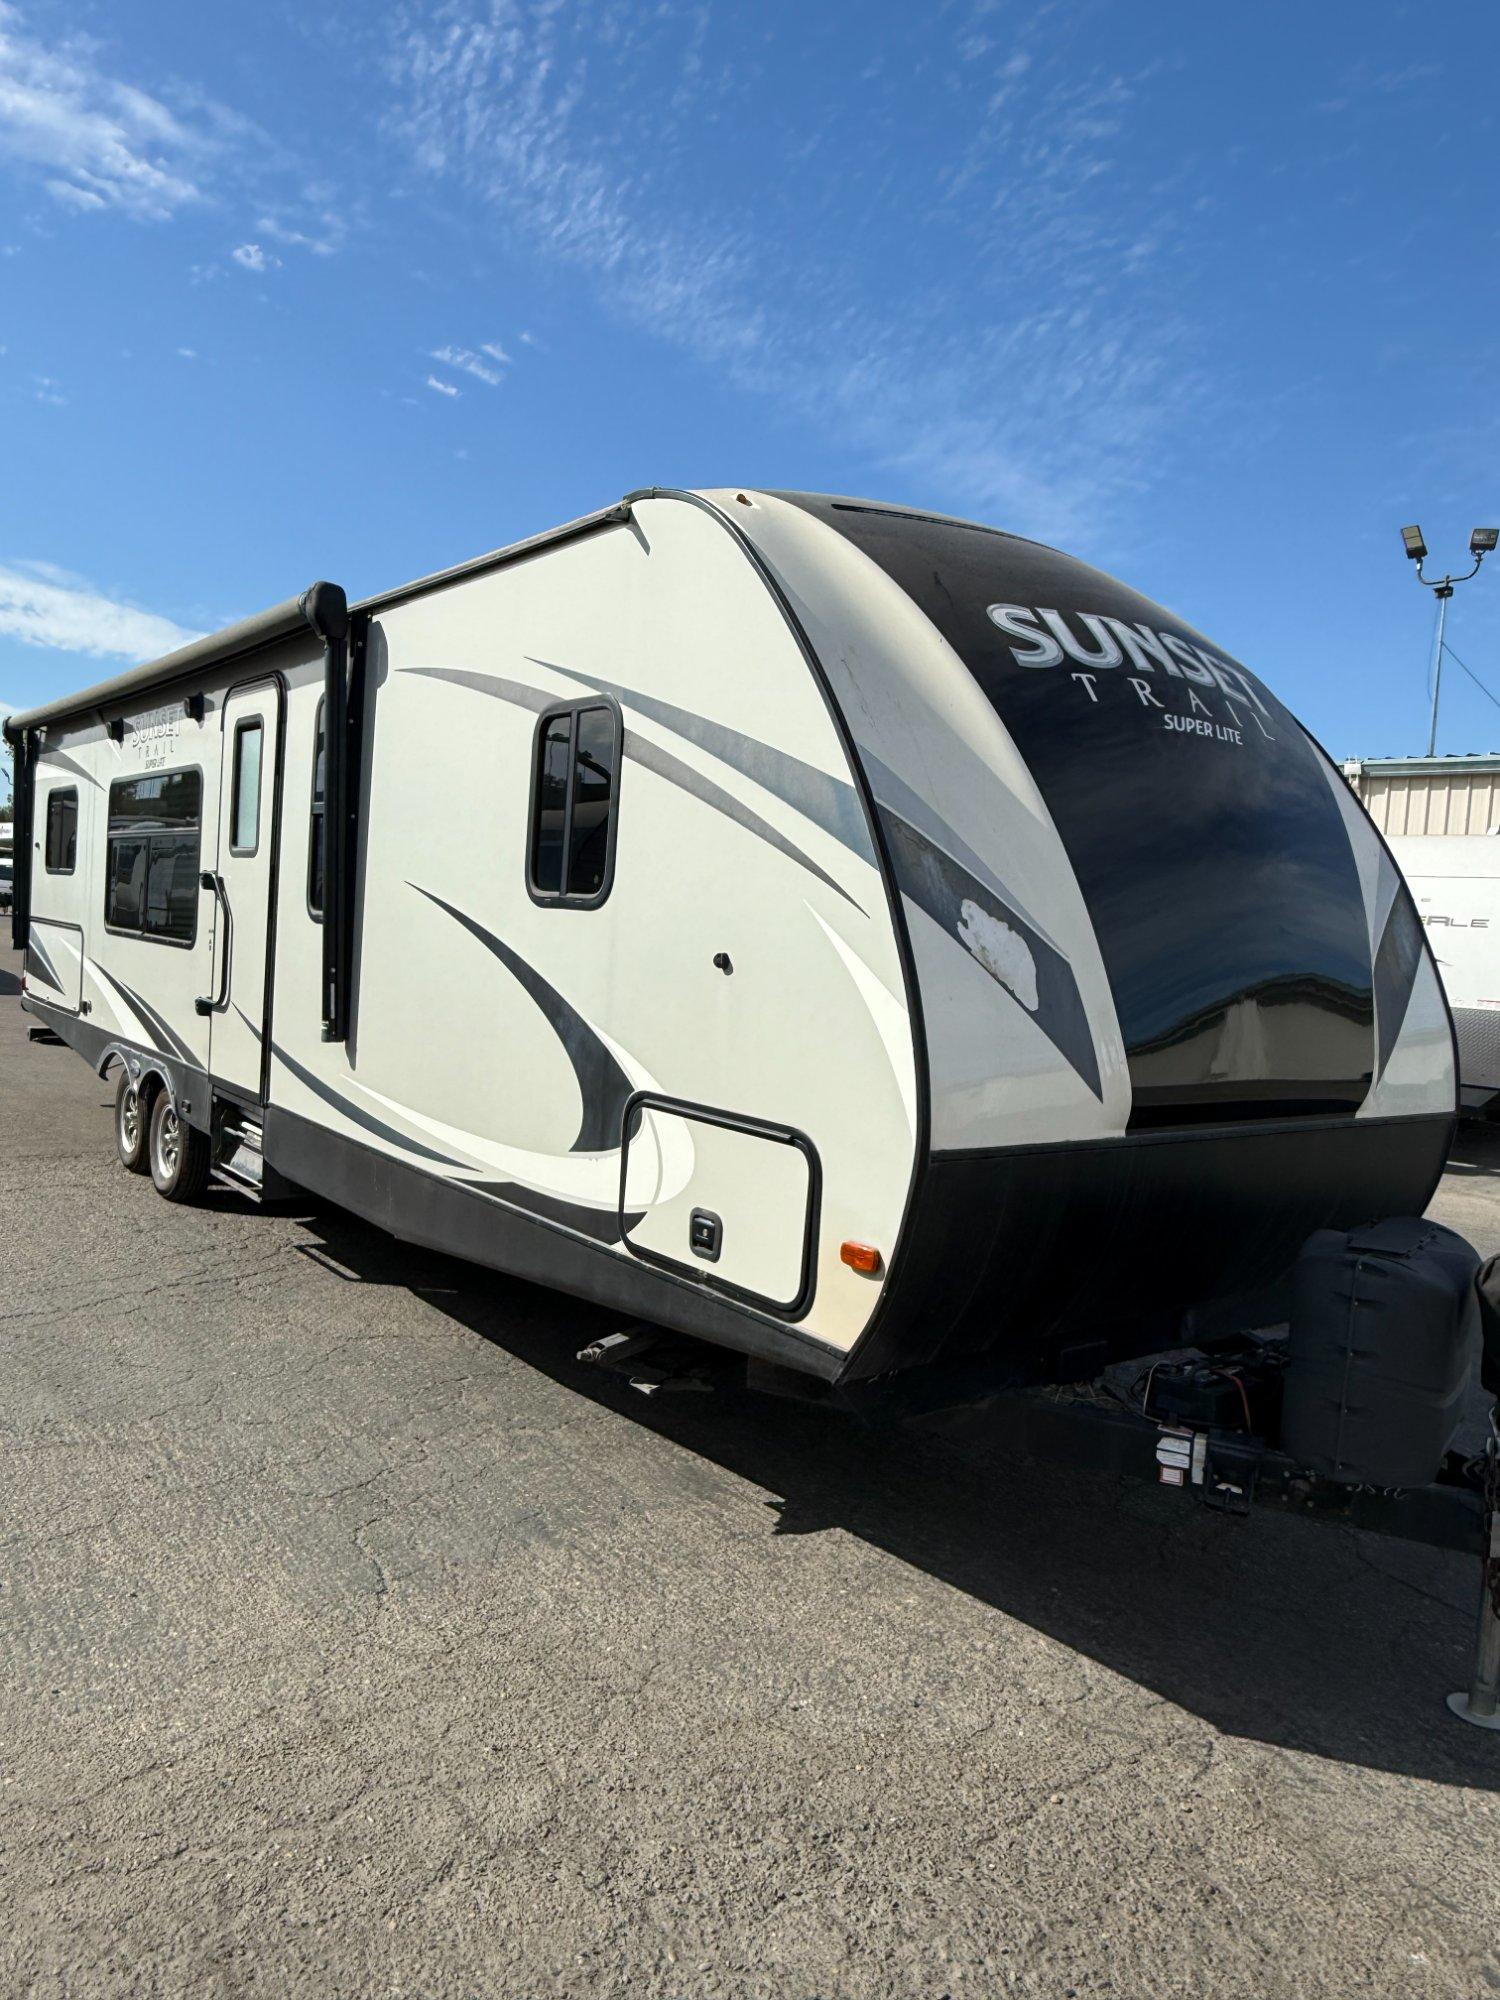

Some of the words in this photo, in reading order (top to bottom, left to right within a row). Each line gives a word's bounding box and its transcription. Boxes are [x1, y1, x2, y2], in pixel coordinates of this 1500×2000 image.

[986, 603, 1273, 721] SUNSET
[132, 706, 184, 748] SUNSET
[1071, 673, 1276, 741] TRAIL
[138, 739, 175, 760] TRAIL
[1164, 714, 1213, 738] SUPER
[1215, 724, 1243, 746] LITE
